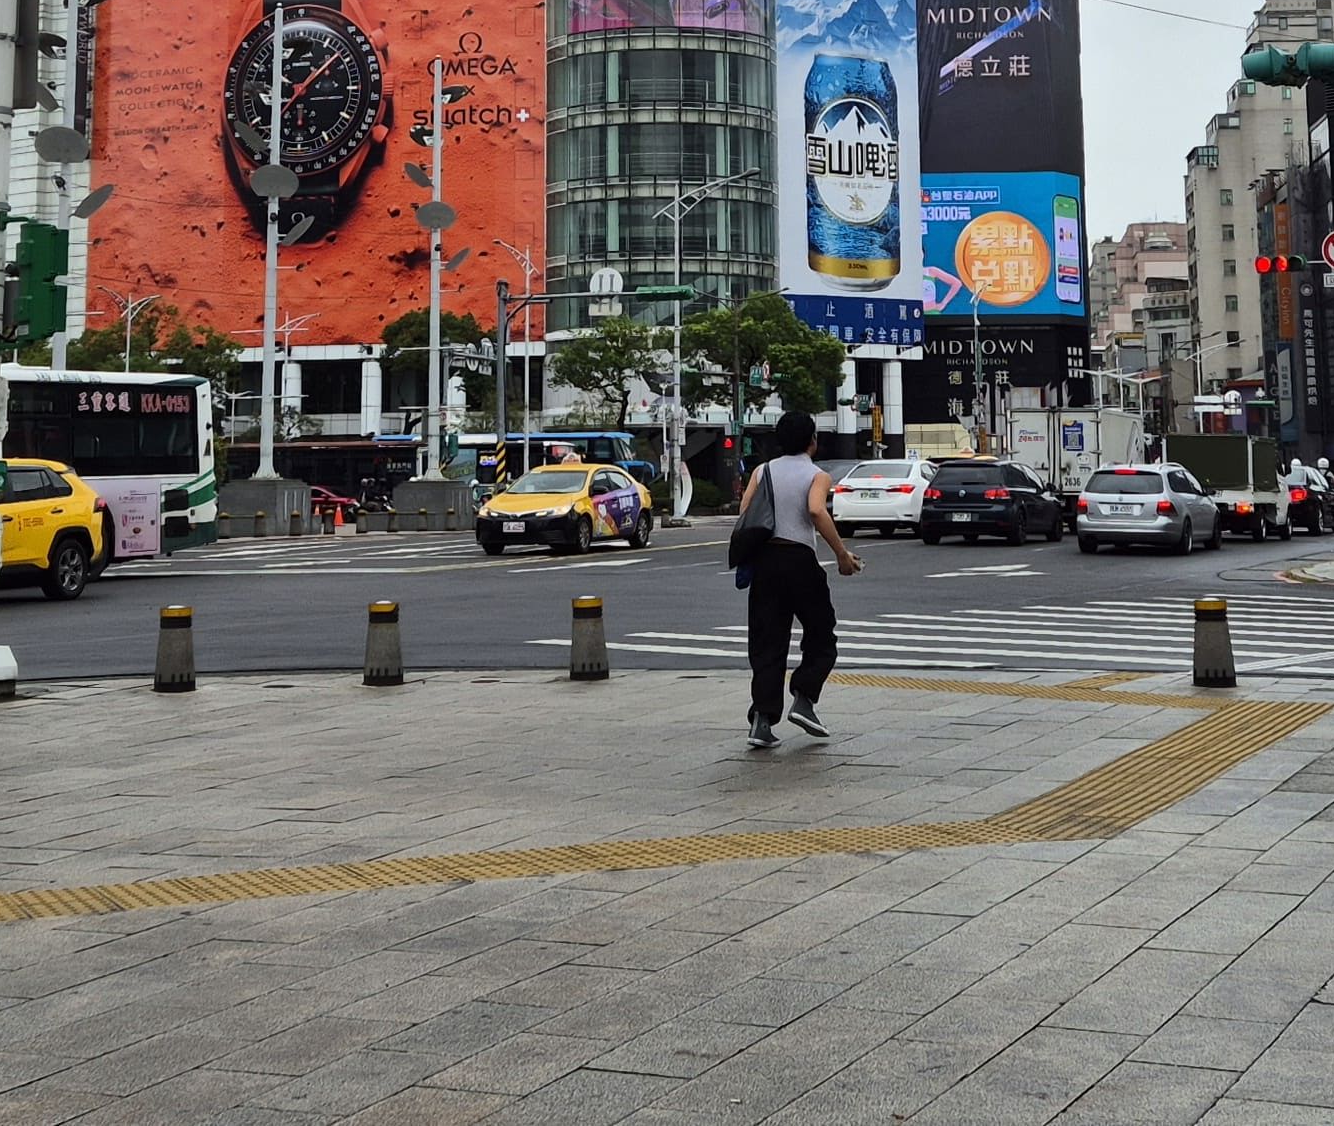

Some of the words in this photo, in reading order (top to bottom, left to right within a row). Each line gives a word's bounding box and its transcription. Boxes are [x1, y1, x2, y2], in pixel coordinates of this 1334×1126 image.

[927, 6, 1053, 24] MIDTOWN
[956, 31, 1025, 40] RICHADSON
[427, 57, 516, 76] OMEGA
[954, 54, 1031, 78] 德立莊
[806, 133, 898, 181] 雪山啤酒
[969, 224, 1035, 257] 累點
[923, 338, 1035, 356] MIDTOWN
[946, 357, 1009, 367] RICHADSON
[141, 392, 191, 413] KKA-0153
